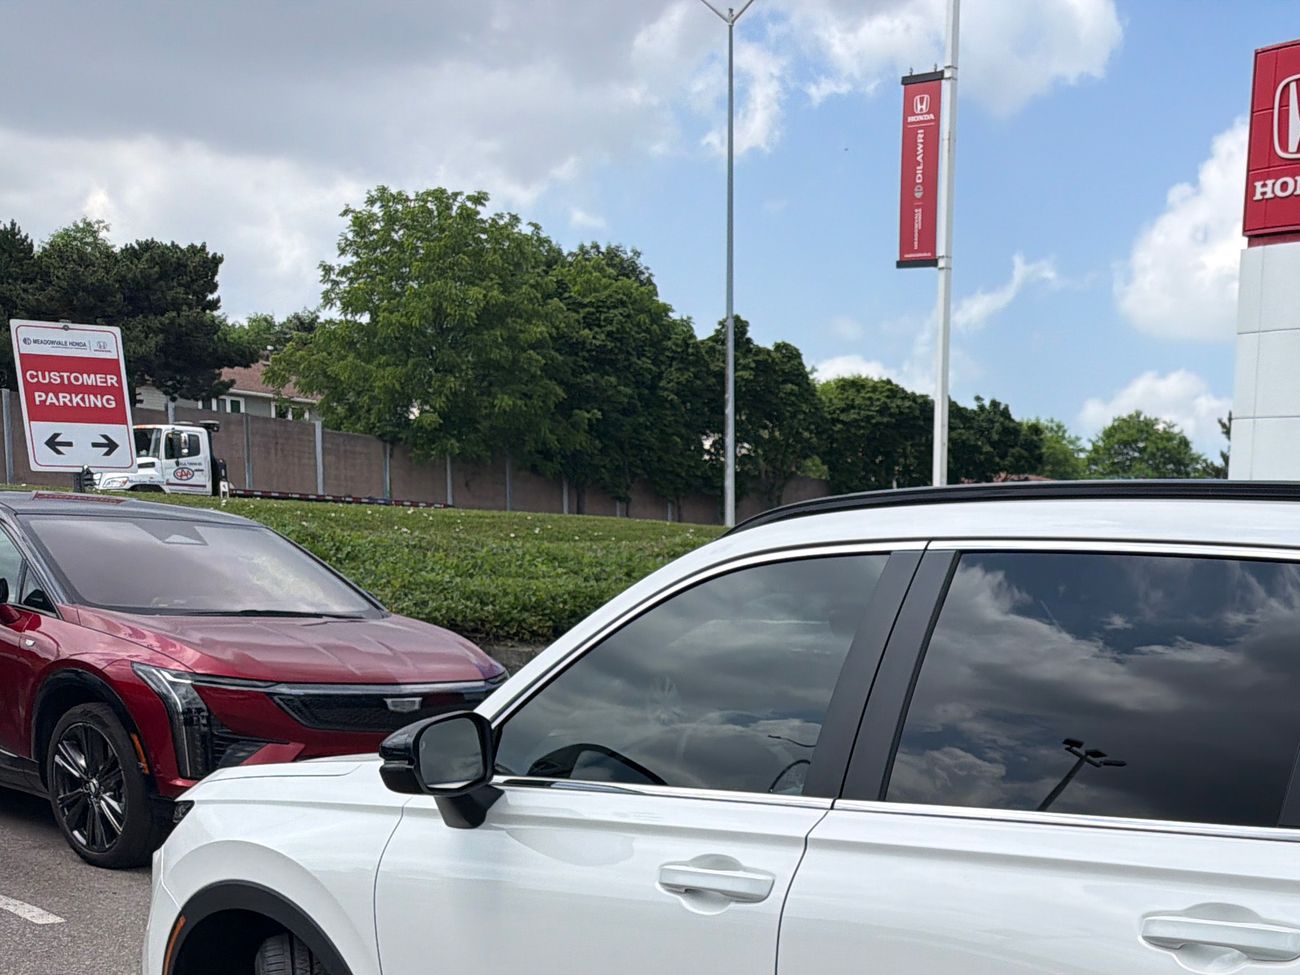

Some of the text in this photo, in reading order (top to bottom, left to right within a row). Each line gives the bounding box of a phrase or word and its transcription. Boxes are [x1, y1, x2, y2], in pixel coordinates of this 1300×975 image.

[907, 113, 935, 122] HONDA
[915, 129, 925, 183] DILAWRI
[26, 370, 119, 387] CUSTOMER
[34, 391, 116, 408] PARKING
